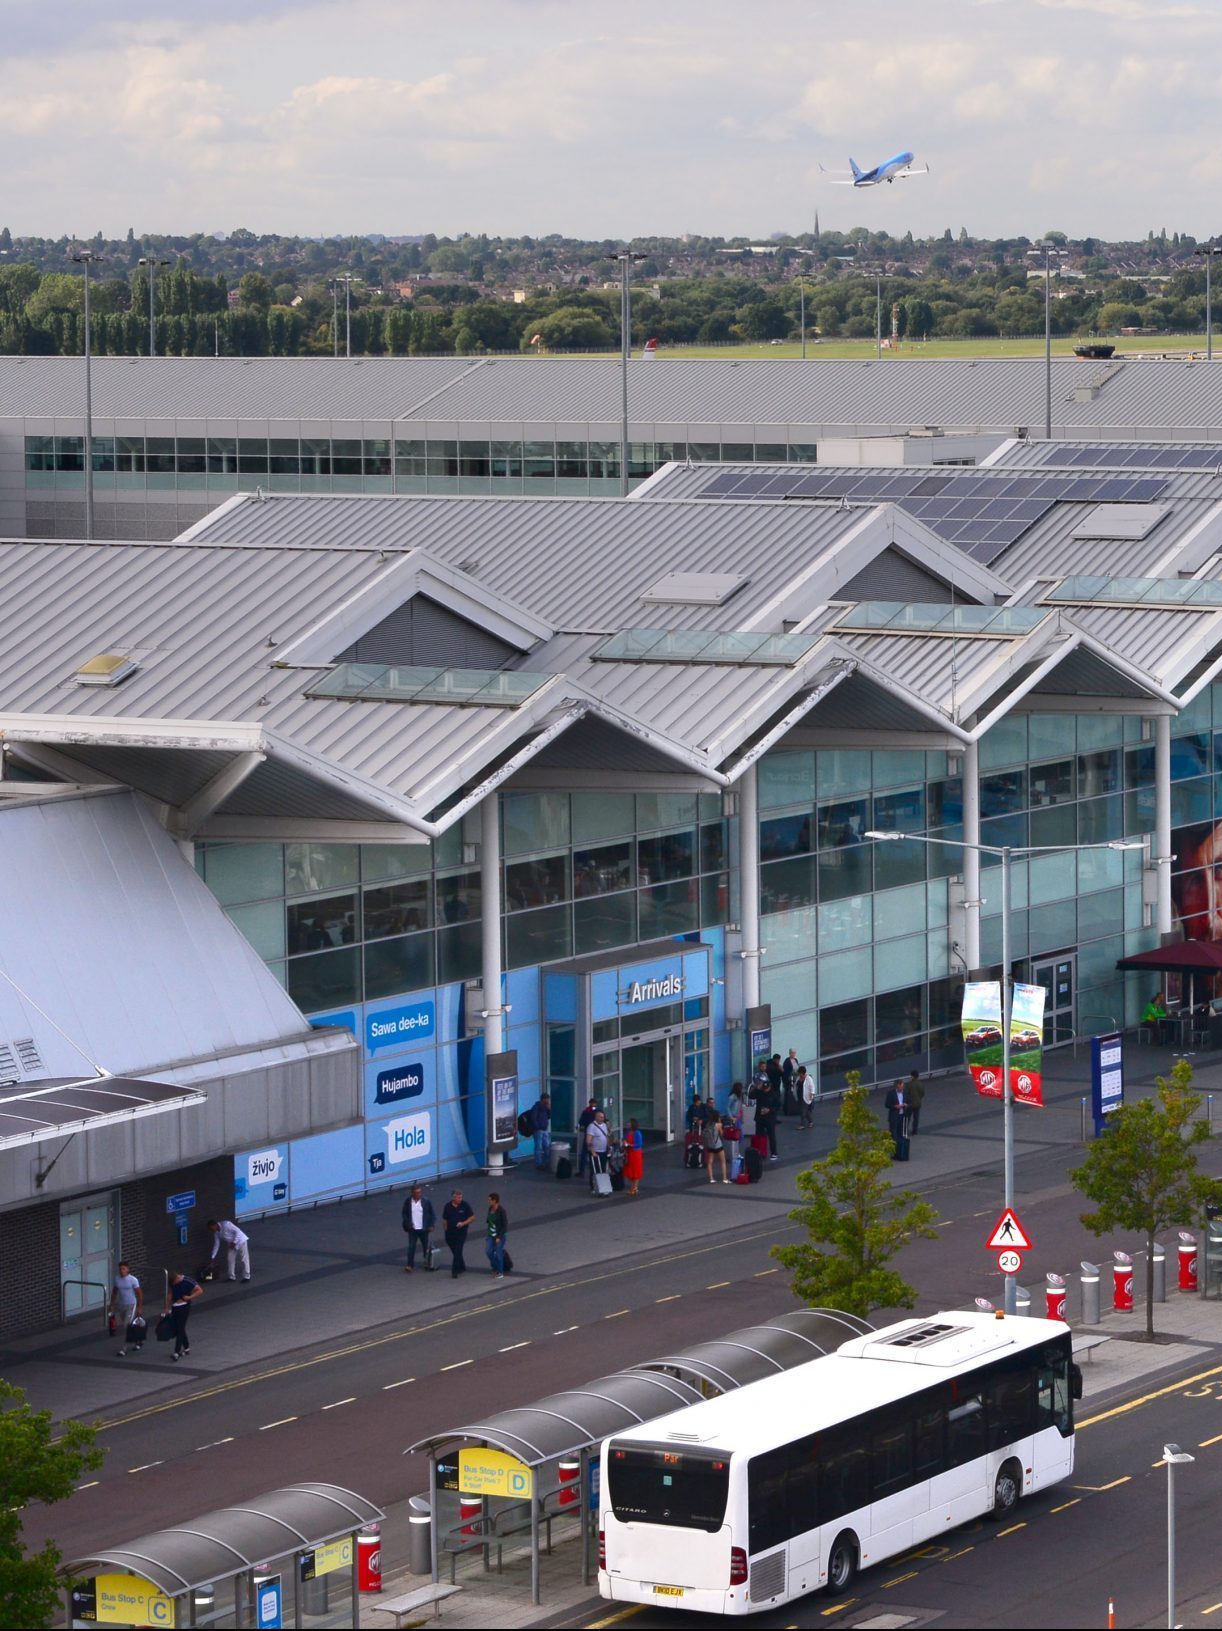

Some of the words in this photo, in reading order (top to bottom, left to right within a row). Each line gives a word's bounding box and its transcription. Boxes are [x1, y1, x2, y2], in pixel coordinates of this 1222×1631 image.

[631, 974, 681, 1003] Arrivals
[371, 1022, 397, 1037] Sawa
[398, 1014, 429, 1031] dee-ka
[382, 1074, 418, 1094] Hujambo
[395, 1125, 425, 1151] Hola
[252, 1157, 275, 1176] živjo
[1001, 1256, 1018, 1266] 20
[464, 1465, 478, 1473] Bus
[480, 1466, 497, 1476] Stop
[498, 1468, 504, 1476] D
[512, 1475, 525, 1490] D
[616, 1506, 647, 1514] CITARO
[343, 1545, 349, 1559] C
[102, 1593, 116, 1601] Bus
[118, 1593, 136, 1604] Stop
[138, 1595, 144, 1604] C
[153, 1602, 166, 1619] C
